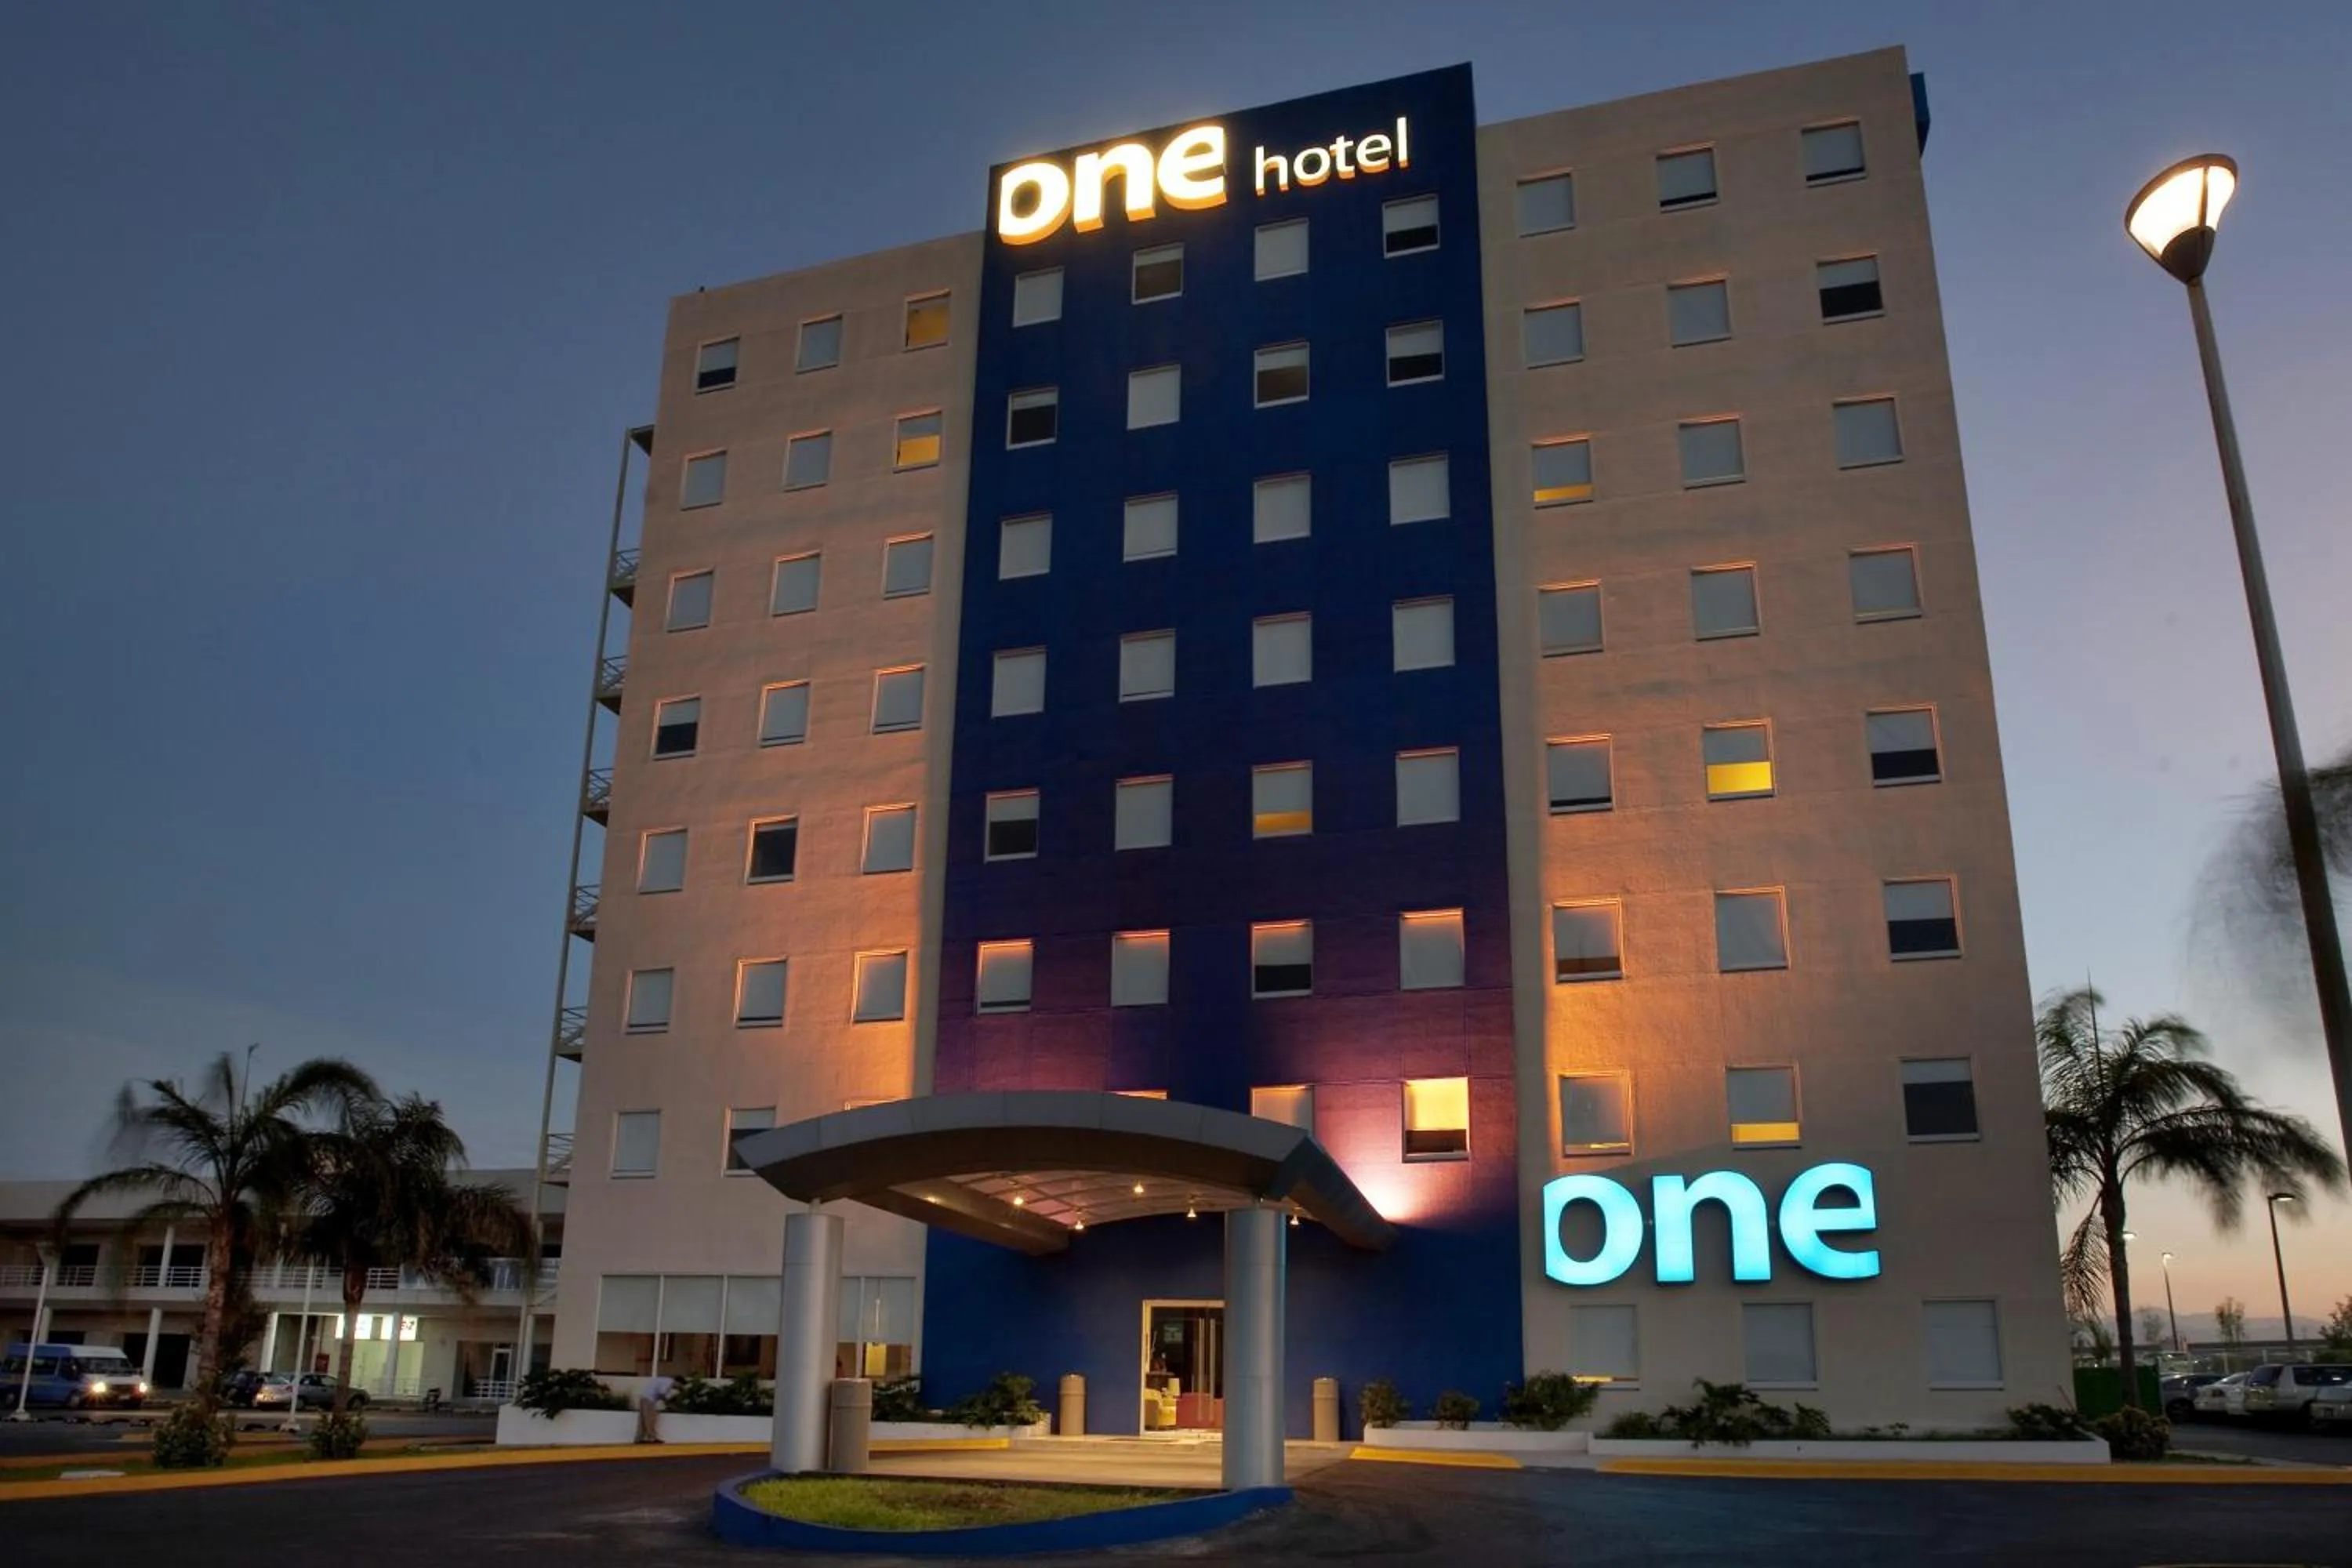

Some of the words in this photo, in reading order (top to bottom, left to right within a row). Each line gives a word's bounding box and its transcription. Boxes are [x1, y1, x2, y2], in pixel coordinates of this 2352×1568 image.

[997, 124, 1228, 245] one
[1254, 116, 1409, 195] hotel
[1542, 1162, 1881, 1287] one
